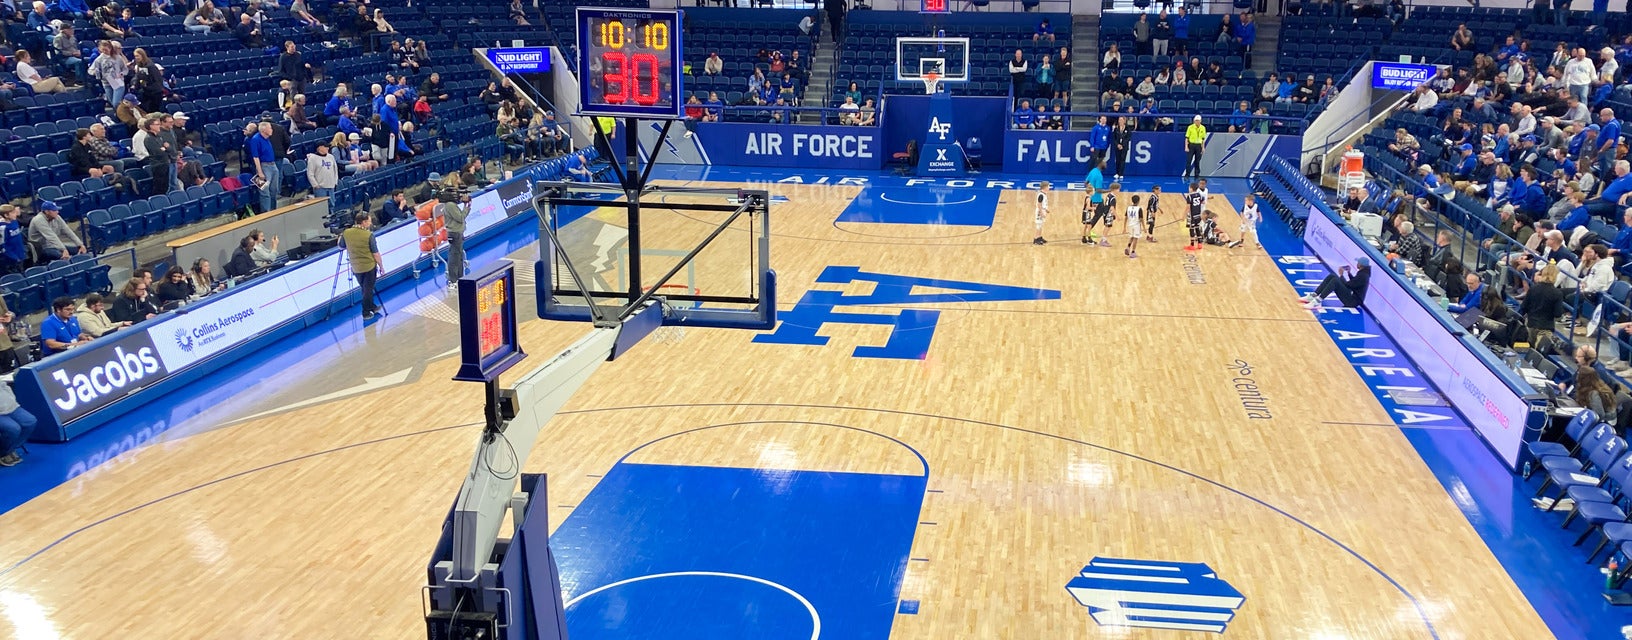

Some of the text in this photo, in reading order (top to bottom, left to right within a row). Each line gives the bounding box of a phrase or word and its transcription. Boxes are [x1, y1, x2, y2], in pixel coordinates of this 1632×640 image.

[603, 11, 652, 19] DAKTRONICS
[600, 20, 668, 51] 10:10
[516, 53, 540, 61] LIGHT
[602, 52, 659, 105] 30
[1382, 69, 1400, 77] BUD
[745, 132, 872, 158] AIR FORCE
[1017, 139, 1152, 164] FALCS
[778, 175, 870, 185] AIR
[193, 306, 255, 339] Collins Aerospace
[52, 346, 159, 411] Jacobs
[1232, 377, 1273, 420] centura
